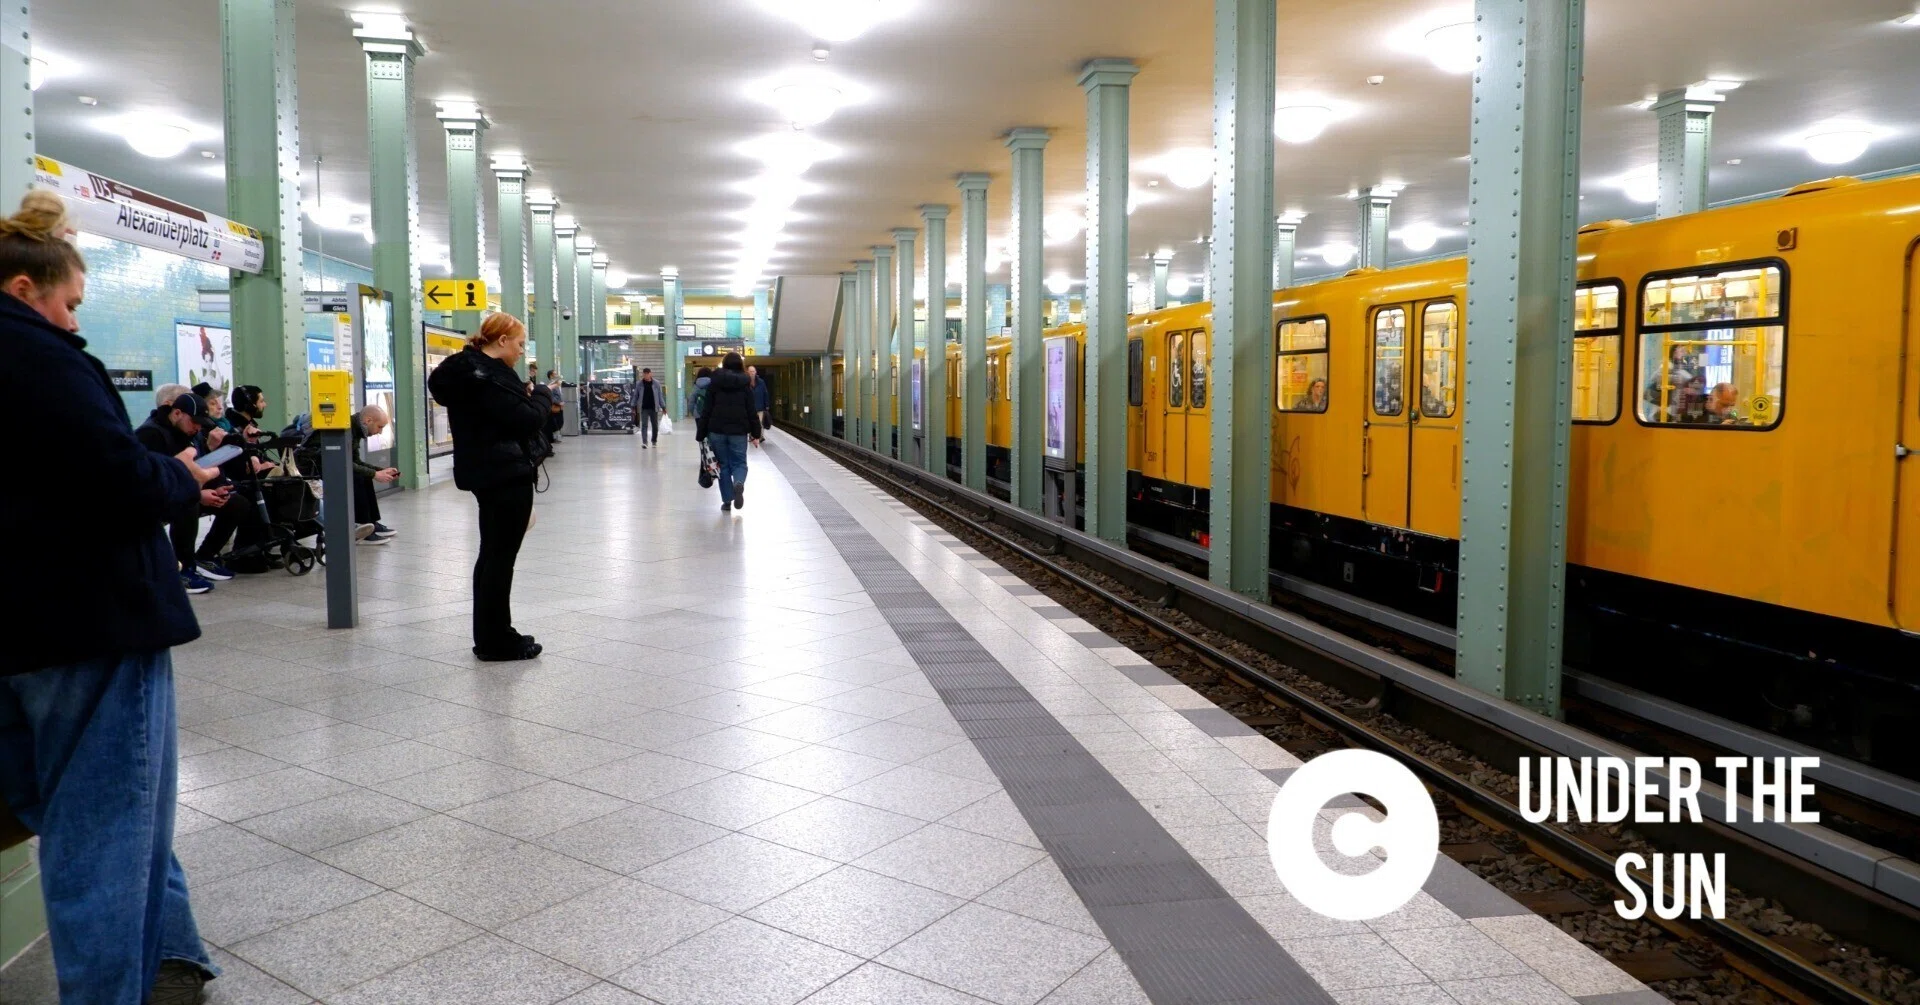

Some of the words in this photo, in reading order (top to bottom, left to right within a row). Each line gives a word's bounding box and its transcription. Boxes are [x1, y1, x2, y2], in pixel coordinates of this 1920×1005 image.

[90, 176, 114, 199] U5
[117, 202, 209, 249] Alexanderplatz
[112, 375, 149, 387] xanderplatz
